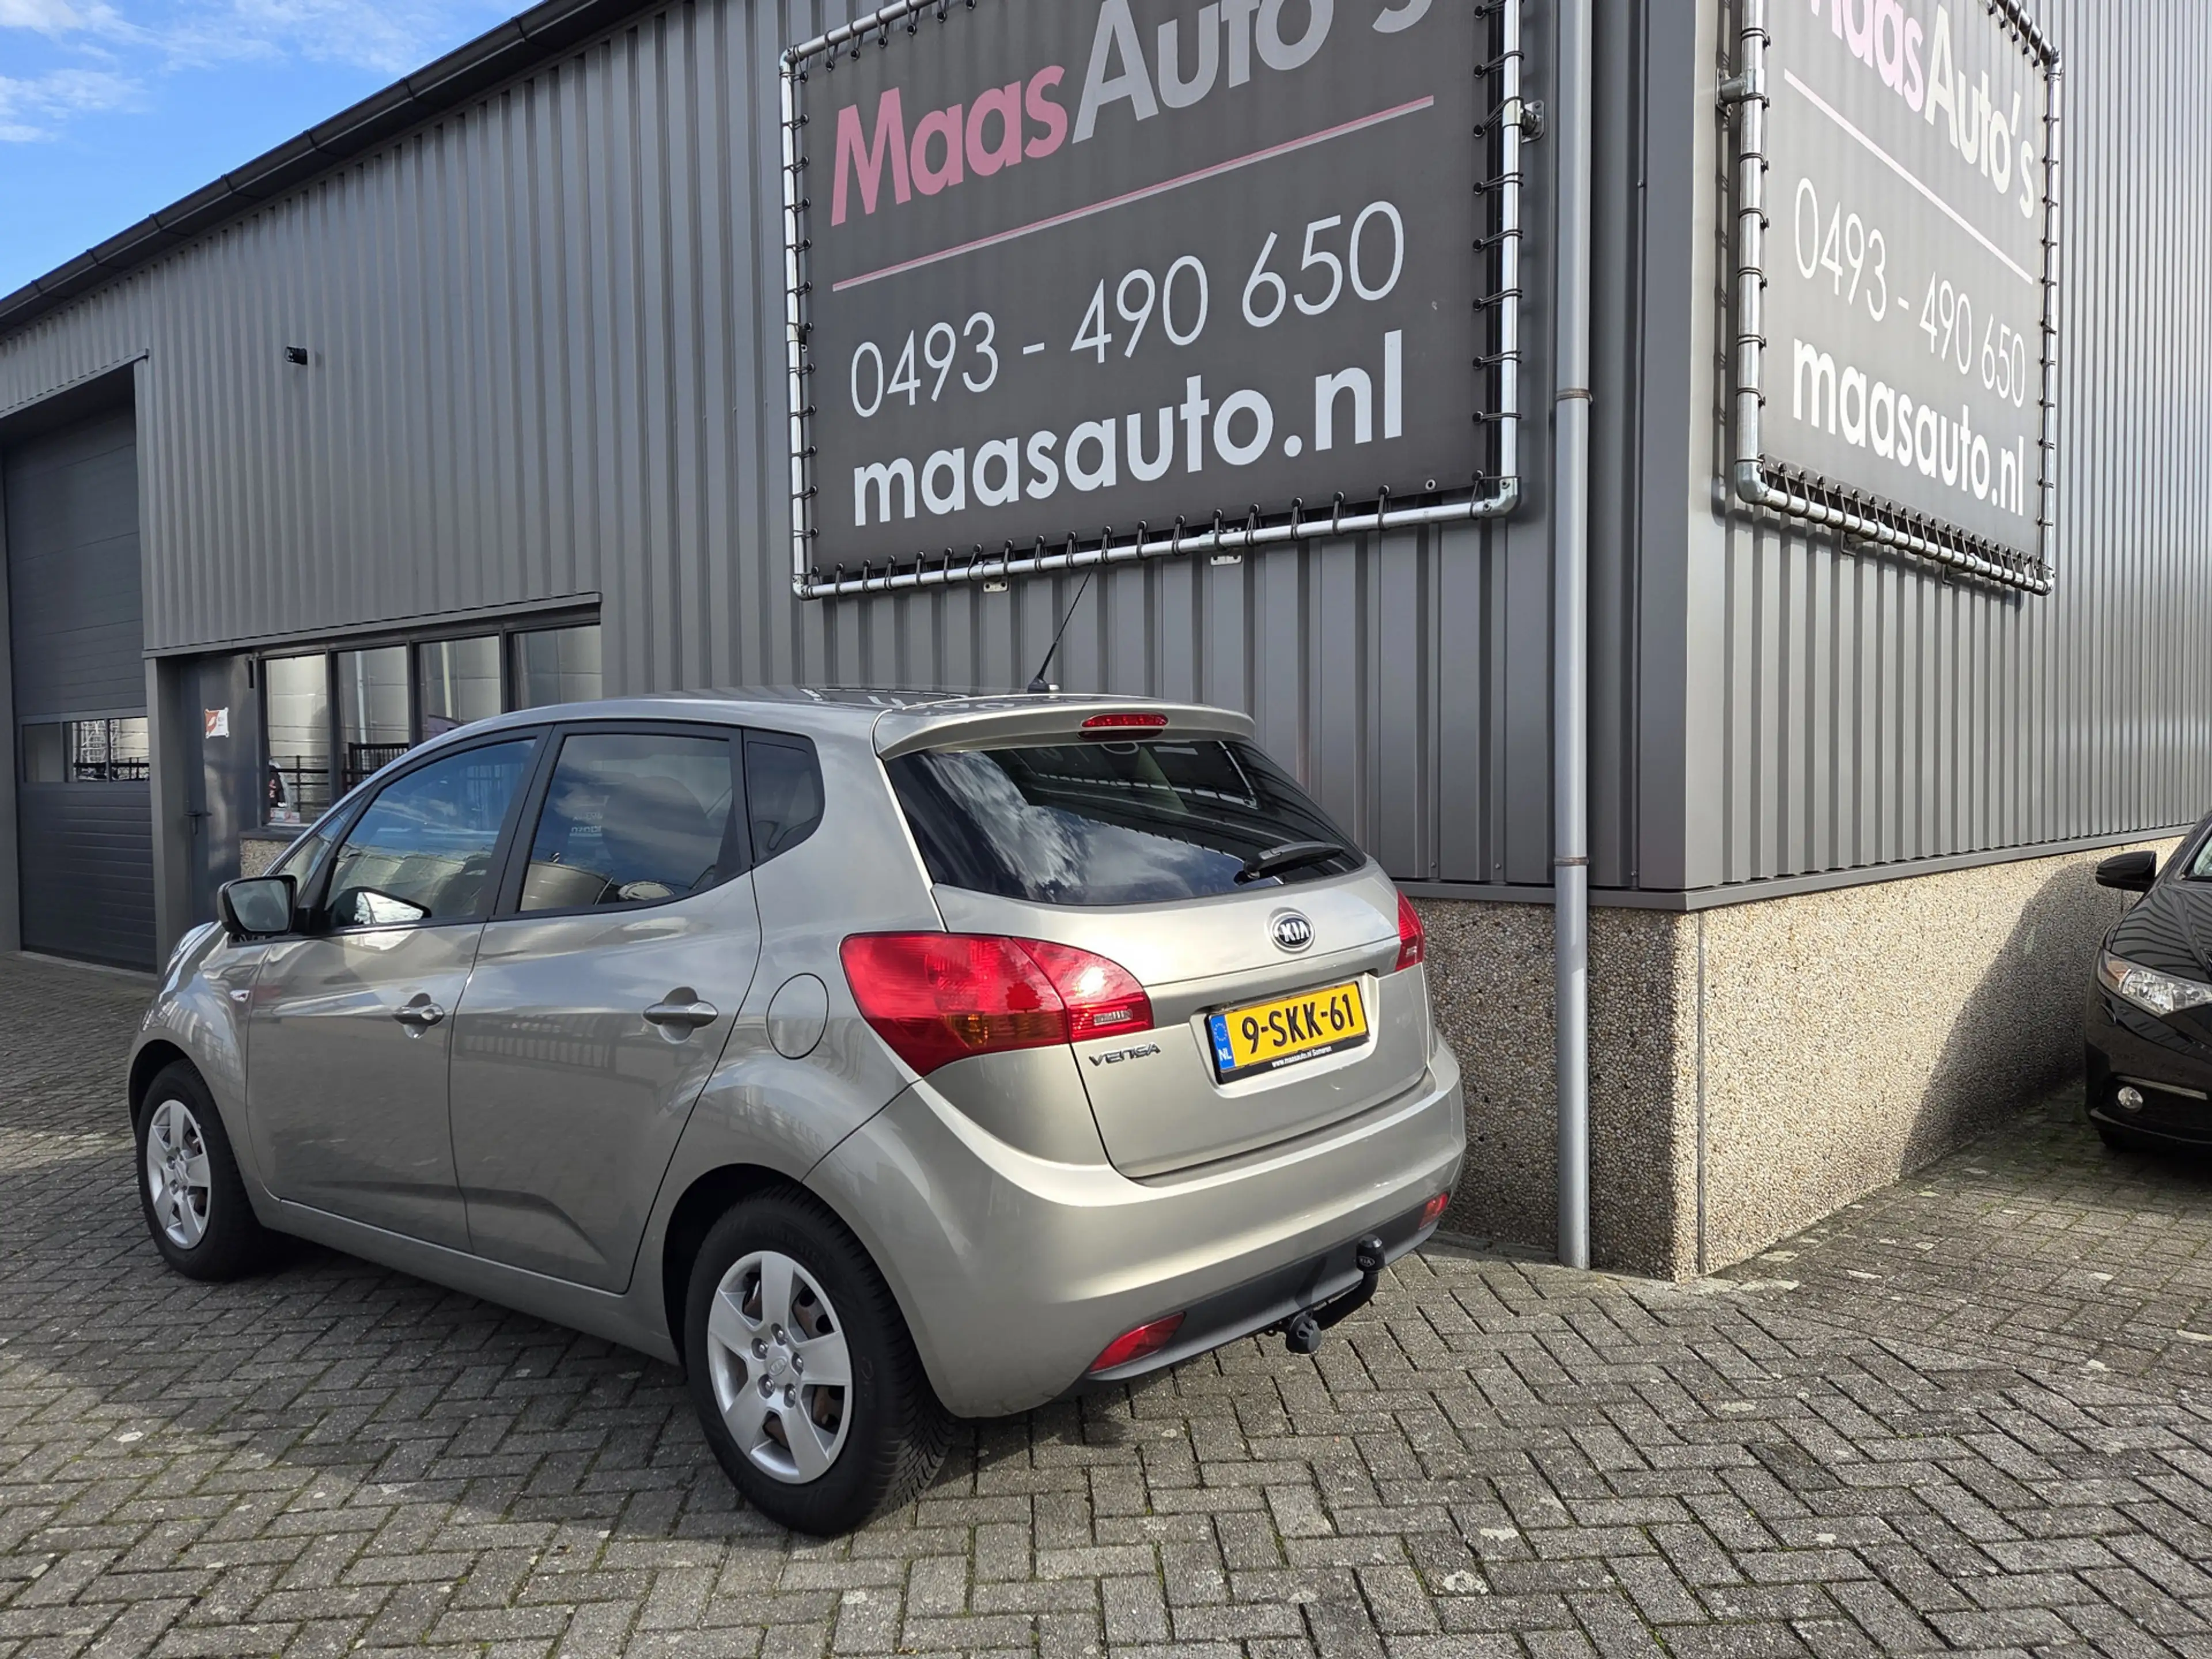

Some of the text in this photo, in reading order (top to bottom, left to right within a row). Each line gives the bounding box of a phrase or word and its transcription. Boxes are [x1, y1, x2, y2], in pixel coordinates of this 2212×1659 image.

[831, 0, 1433, 226] MaasAuto
[1810, 0, 2034, 218] aasAuto's
[851, 312, 999, 418] 0493
[1070, 255, 1209, 363] 490
[1243, 201, 1404, 327] 650
[1795, 178, 1887, 321] 0493
[1919, 272, 1972, 374] 490
[1982, 314, 2025, 407] 650
[854, 329, 1402, 527] maasauto.nl
[1793, 338, 2024, 516] maasauto.nl
[1242, 994, 1354, 1054] 9-SKK-61
[1280, 921, 1310, 942] KIA
[1217, 1047, 1233, 1061] NL
